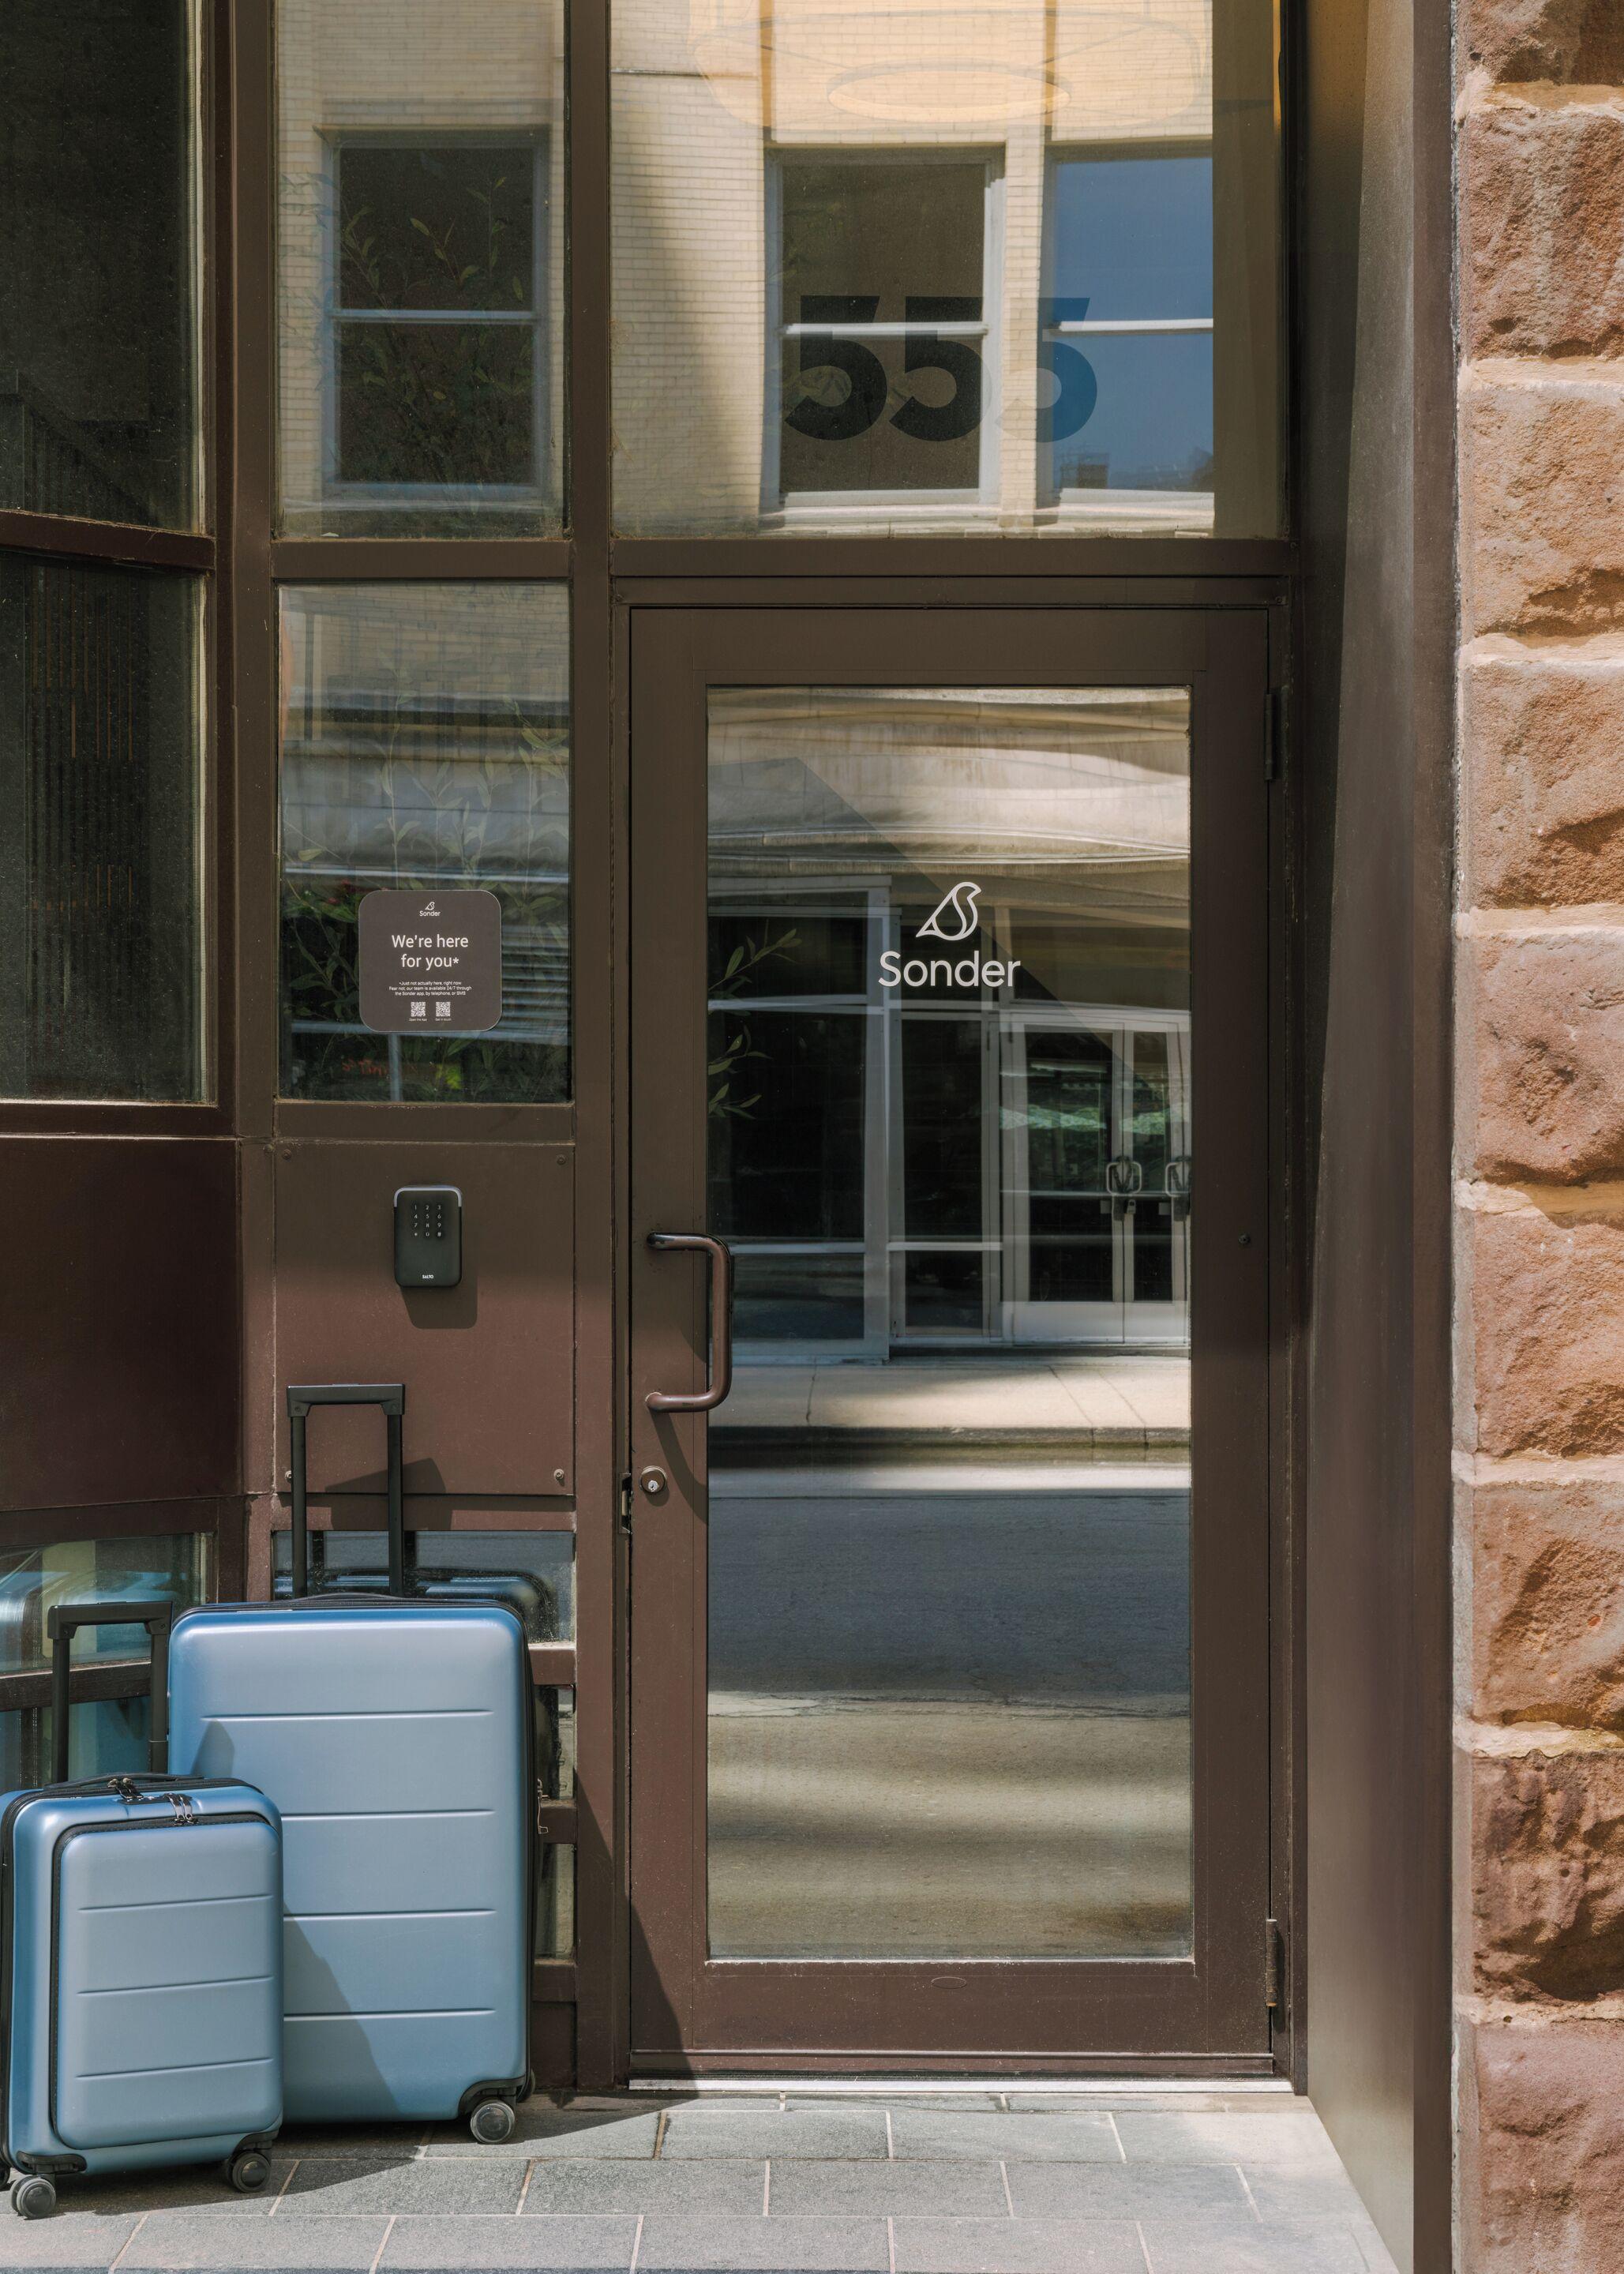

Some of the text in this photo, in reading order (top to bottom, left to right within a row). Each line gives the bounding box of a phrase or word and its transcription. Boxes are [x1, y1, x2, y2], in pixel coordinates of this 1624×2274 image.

[784, 295, 1098, 443] 555
[392, 934, 469, 948] We're here
[401, 954, 422, 968] for
[878, 950, 1022, 988] Sonder
